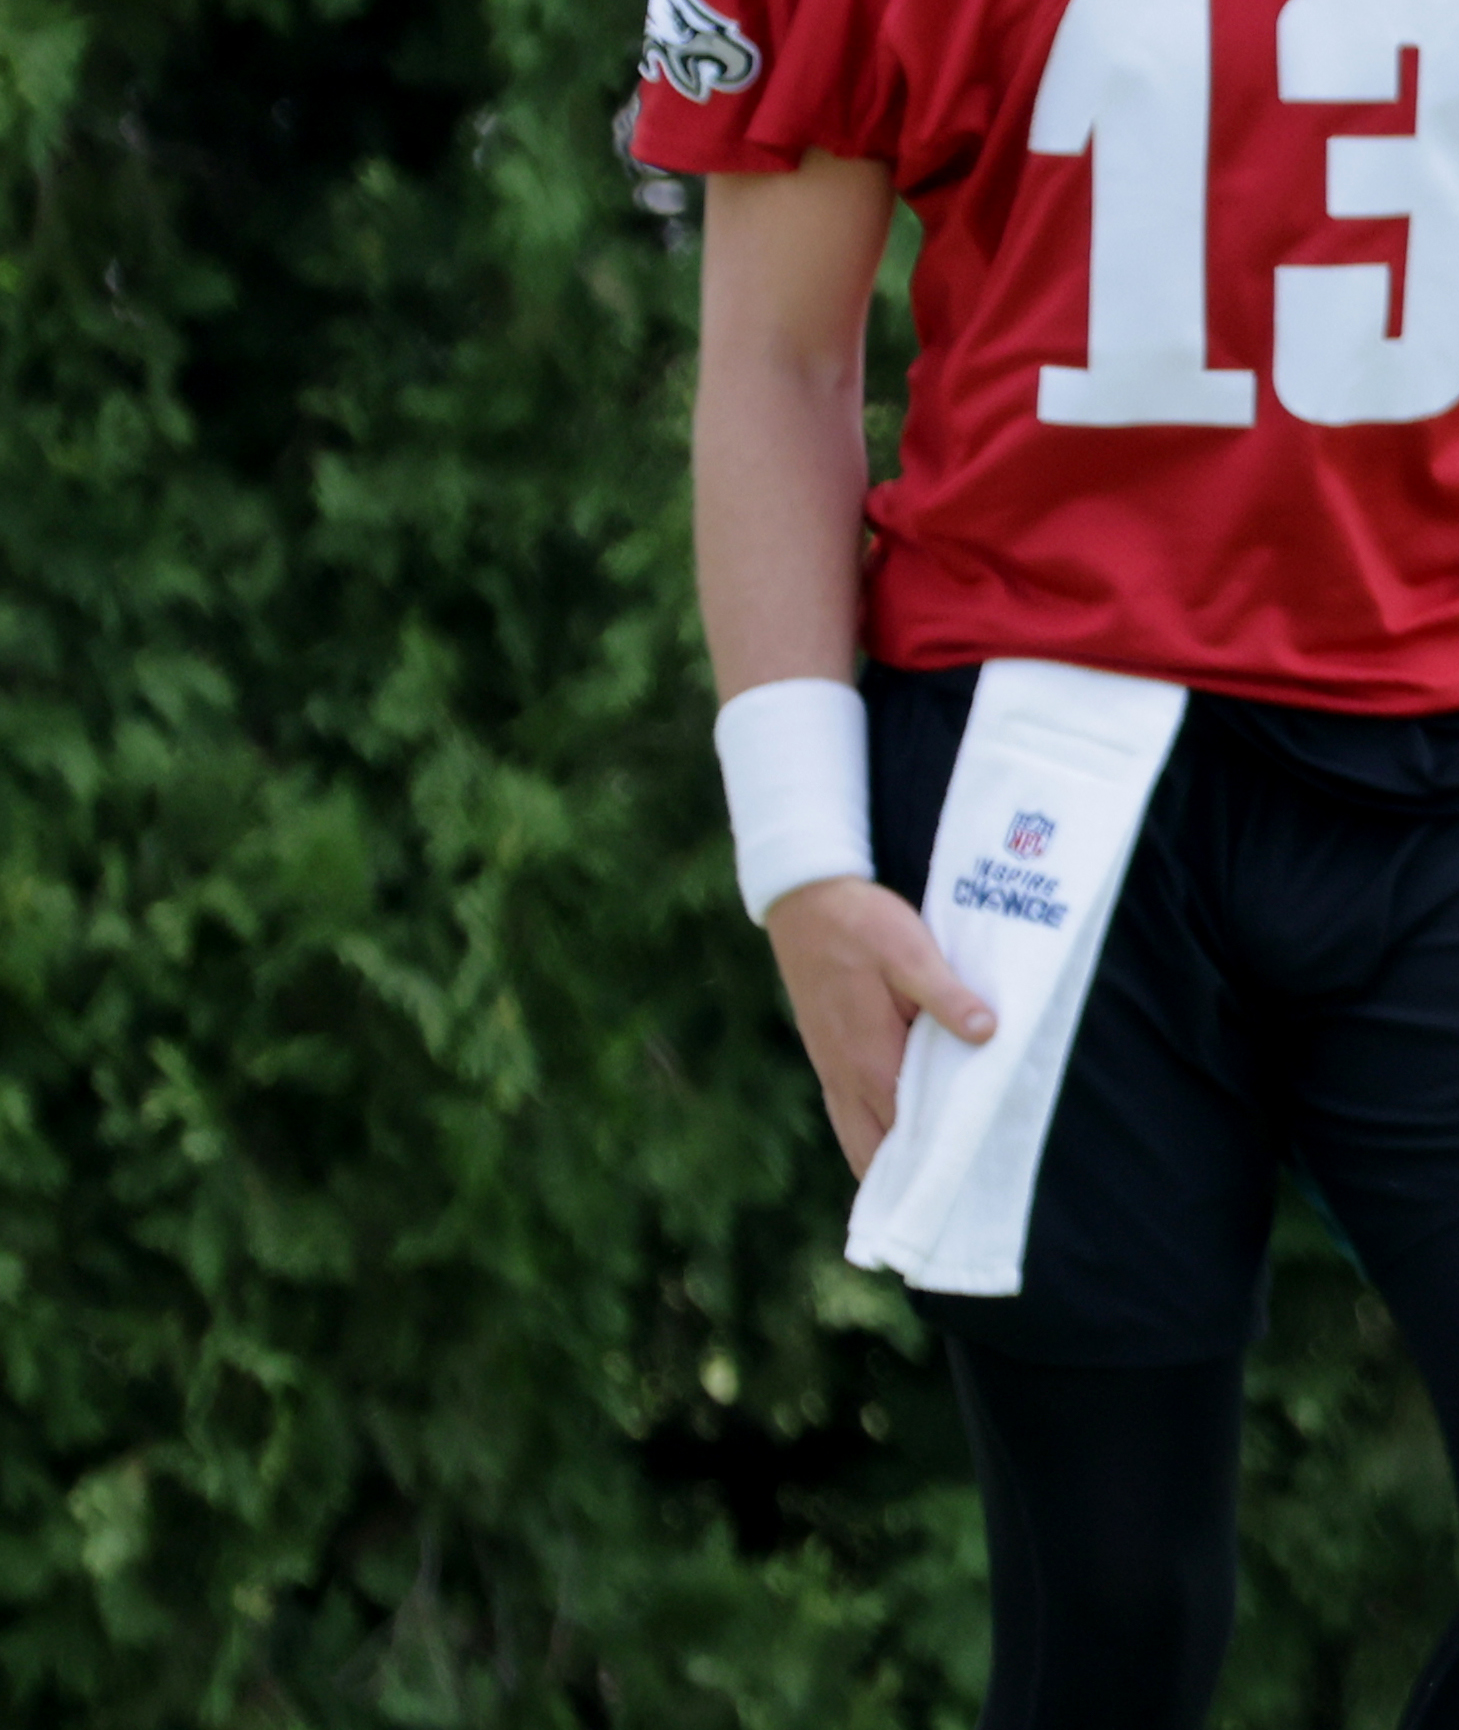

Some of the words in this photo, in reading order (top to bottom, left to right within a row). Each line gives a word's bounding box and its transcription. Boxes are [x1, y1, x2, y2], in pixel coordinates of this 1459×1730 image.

[1007, 828, 1044, 858] NFL
[974, 856, 1060, 895] INSPIRE
[952, 875, 1070, 930] CHANGE
